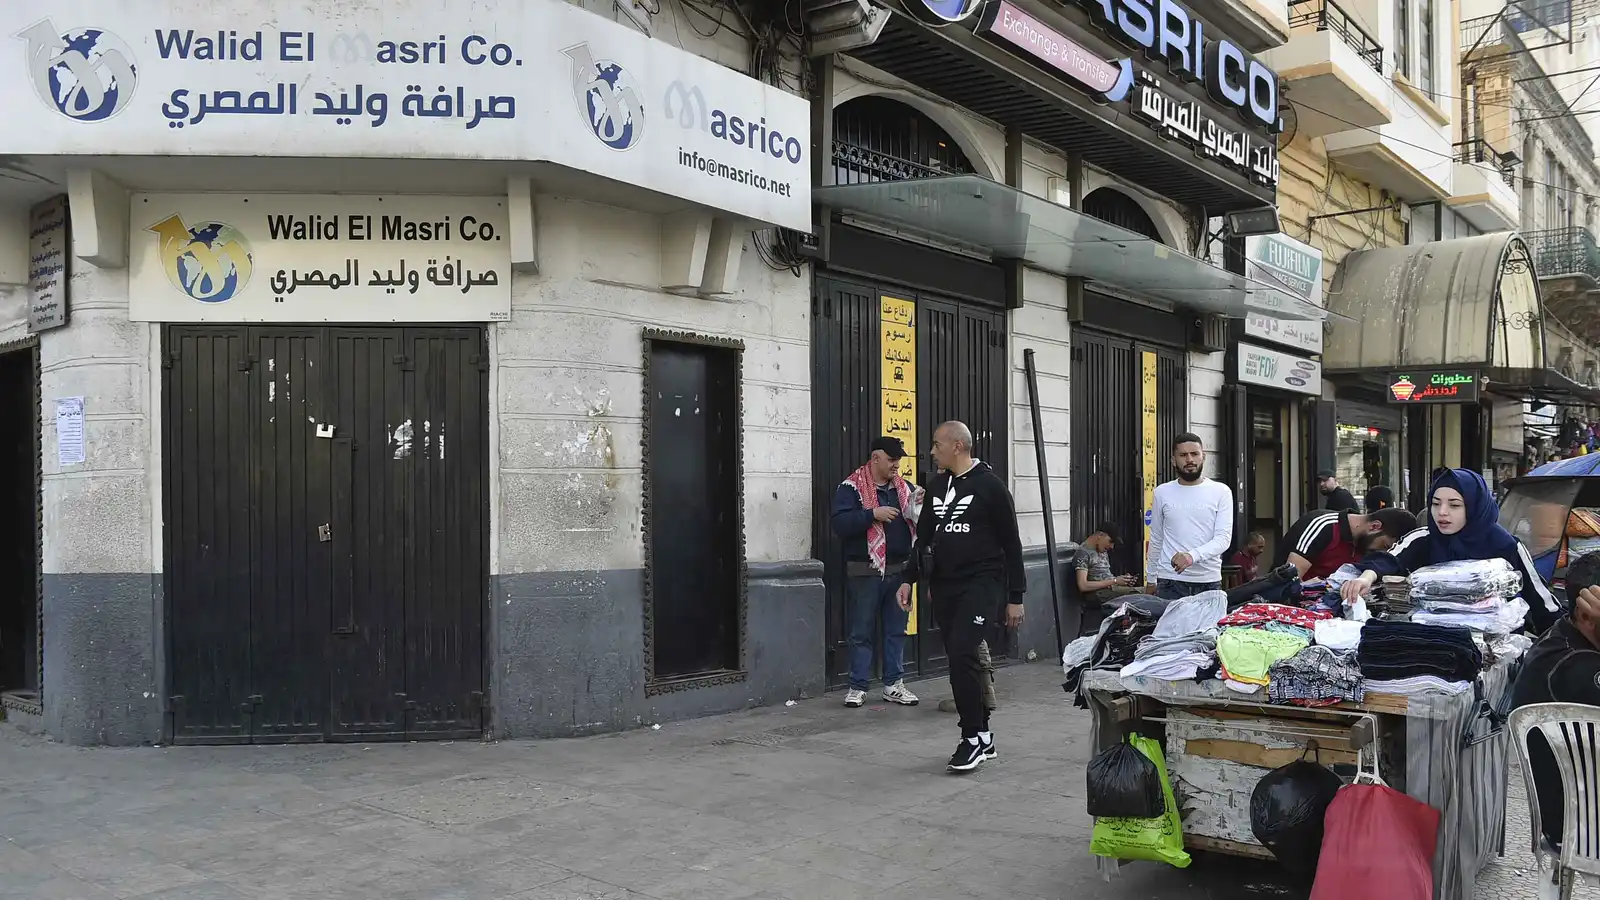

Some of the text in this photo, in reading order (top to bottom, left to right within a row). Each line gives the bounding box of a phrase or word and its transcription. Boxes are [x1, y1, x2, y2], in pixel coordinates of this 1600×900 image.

[155, 29, 262, 61] Walid
[280, 32, 314, 62] El
[461, 35, 523, 66] Co.
[1003, 10, 1109, 86] Exchange & Transfer
[1218, 40, 1284, 132] CO.
[162, 83, 516, 129] صرافة وليد المصري
[1202, 119, 1250, 168] المصري
[679, 147, 791, 198] info@masrico.net
[1253, 146, 1281, 186] وليد
[268, 215, 501, 242] Walid El Masri Co.
[270, 255, 498, 302] صرافة وليد المصري
[1269, 240, 1311, 278] FUJIFILM
[886, 330, 912, 344] رسوم
[1431, 374, 1473, 386] عطورات
[886, 393, 912, 412] ضريبة
[886, 418, 912, 433] الدخل
